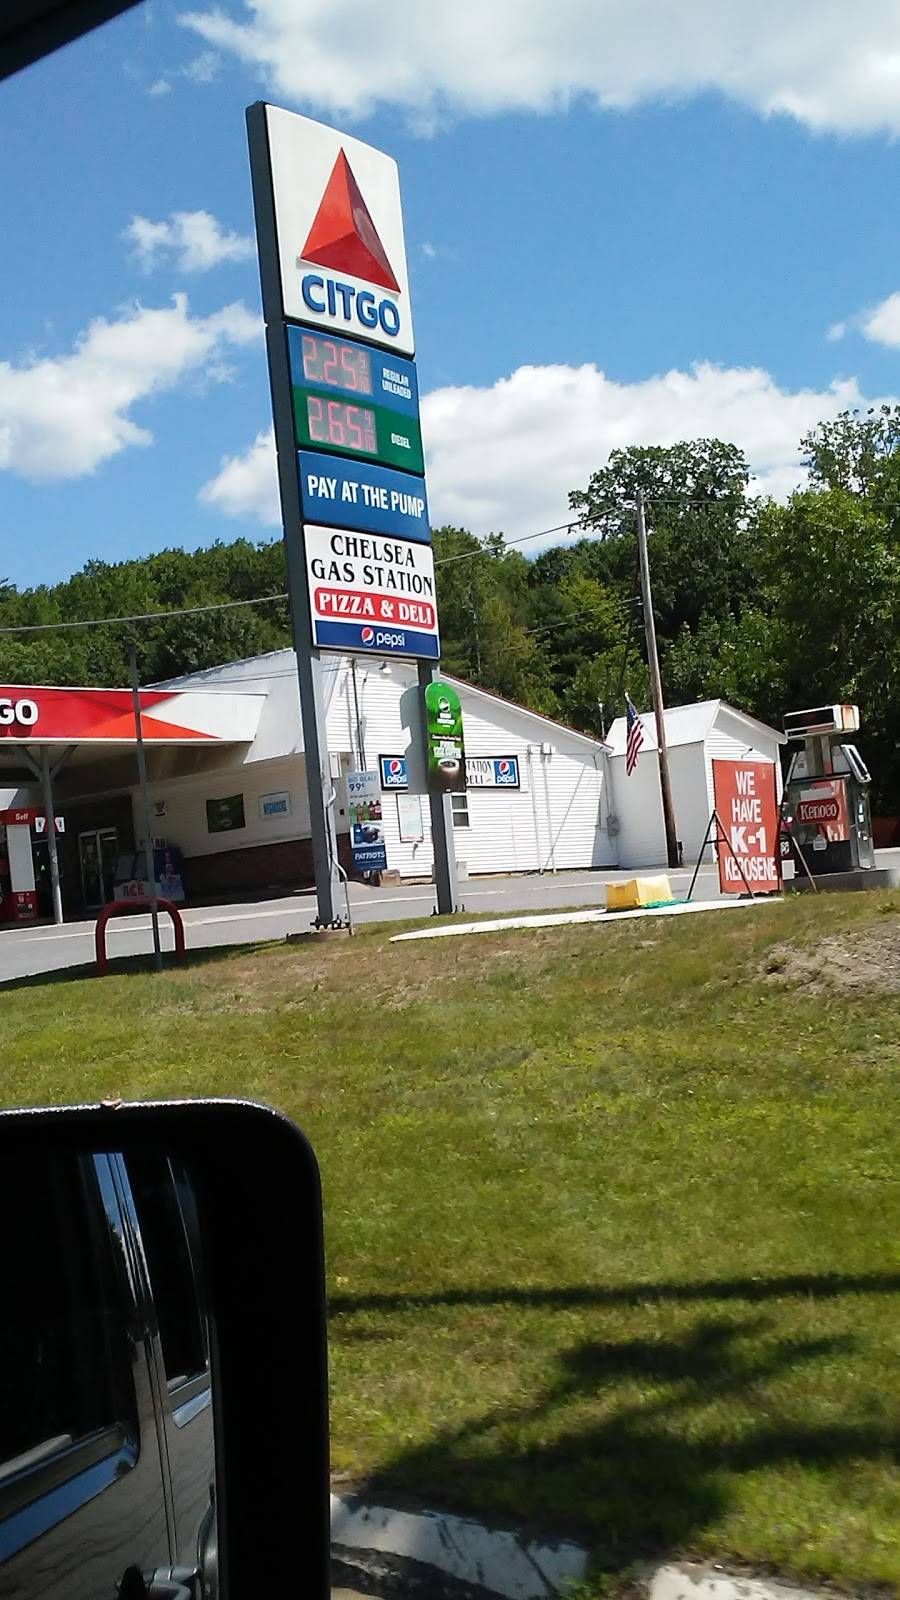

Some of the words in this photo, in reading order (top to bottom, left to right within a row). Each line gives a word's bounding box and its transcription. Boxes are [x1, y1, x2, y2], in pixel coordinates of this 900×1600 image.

[301, 274, 401, 337] CITGO
[382, 367, 409, 387] REGULAR
[382, 379, 412, 399] UNLEADED
[390, 432, 411, 449] DIESEL
[307, 475, 337, 500] PAY
[341, 481, 359, 503] AT
[361, 485, 389, 511] THE
[391, 491, 425, 519] PUMP
[330, 535, 416, 568] CHELSEA
[311, 558, 355, 583] GAS
[363, 565, 434, 596] STATION
[318, 592, 375, 616] PIZZA
[380, 600, 395, 619] &
[399, 605, 432, 625] DELI
[376, 632, 406, 648] pepsi
[466, 760, 492, 774] TATION
[496, 774, 515, 785] pepsi
[735, 771, 757, 796] WE
[731, 799, 762, 823] HAVE
[730, 826, 767, 853] K-1
[354, 851, 385, 860] PATRIOTS
